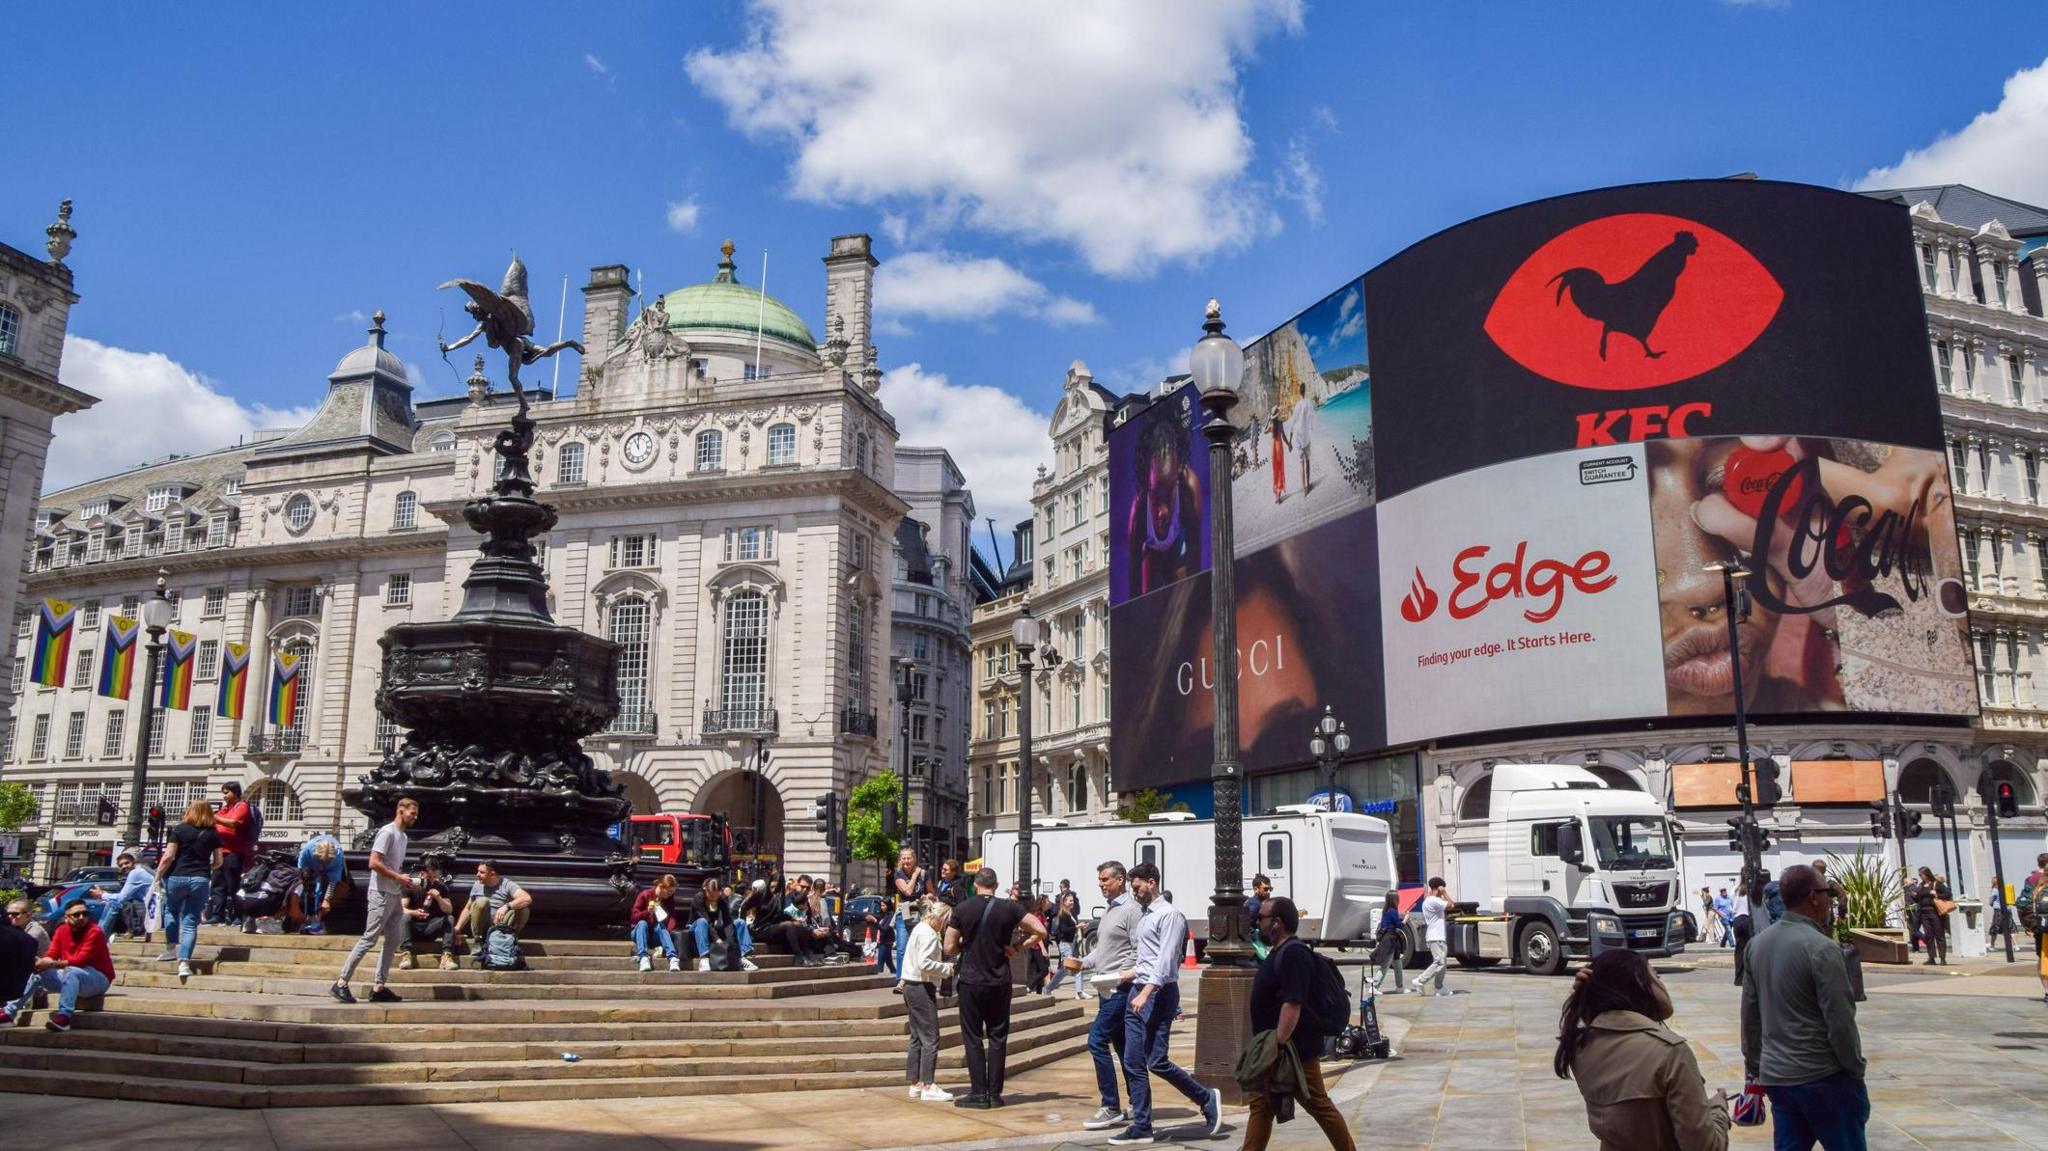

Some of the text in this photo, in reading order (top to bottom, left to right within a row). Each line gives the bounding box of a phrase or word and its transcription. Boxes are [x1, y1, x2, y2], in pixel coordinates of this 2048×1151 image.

[1576, 402, 1712, 448] KFC
[1584, 471, 1626, 480] GUARANTEE
[1448, 541, 1618, 623] Edge
[1417, 631, 1595, 667] Finding your edge. It Starts Here.
[1631, 893, 1656, 902] MAN
